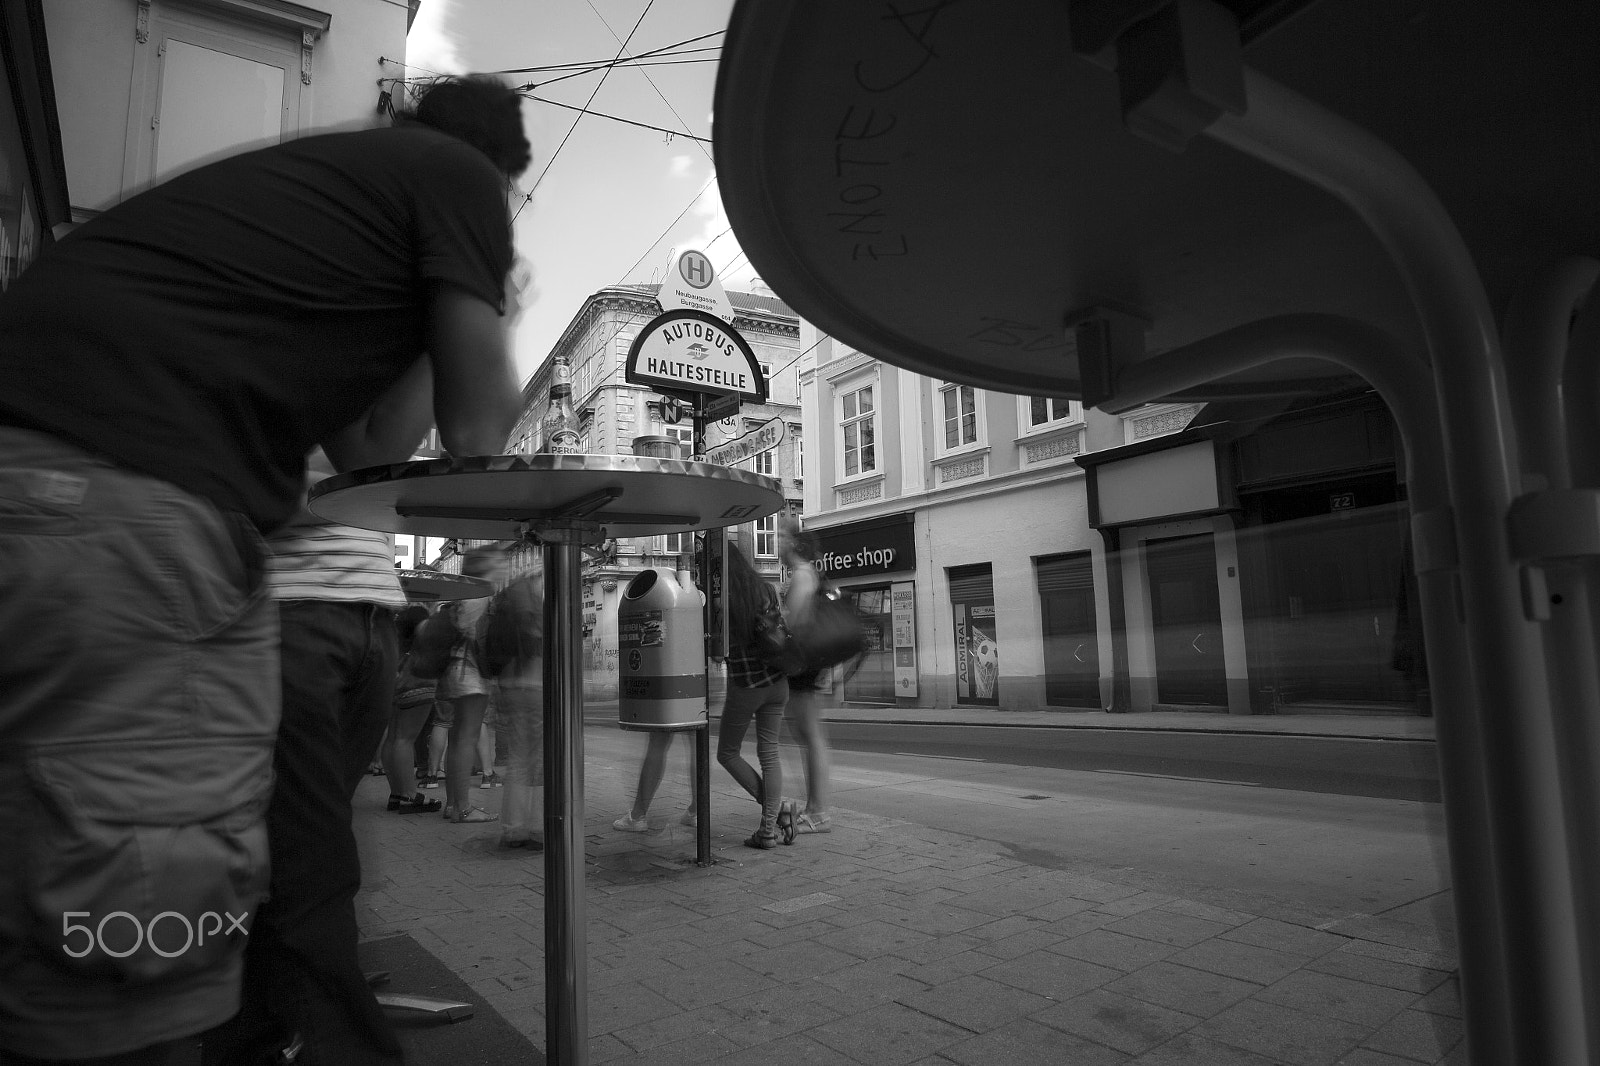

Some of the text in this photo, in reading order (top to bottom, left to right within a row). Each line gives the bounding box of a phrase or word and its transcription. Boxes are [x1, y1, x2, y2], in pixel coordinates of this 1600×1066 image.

[827, 0, 948, 262] ENOTECA
[687, 256, 705, 283] H
[662, 322, 735, 357] AUTOBUS
[647, 357, 746, 389] HALTESTELLE
[856, 546, 894, 569] shop
[957, 616, 968, 684] ADMIRAL
